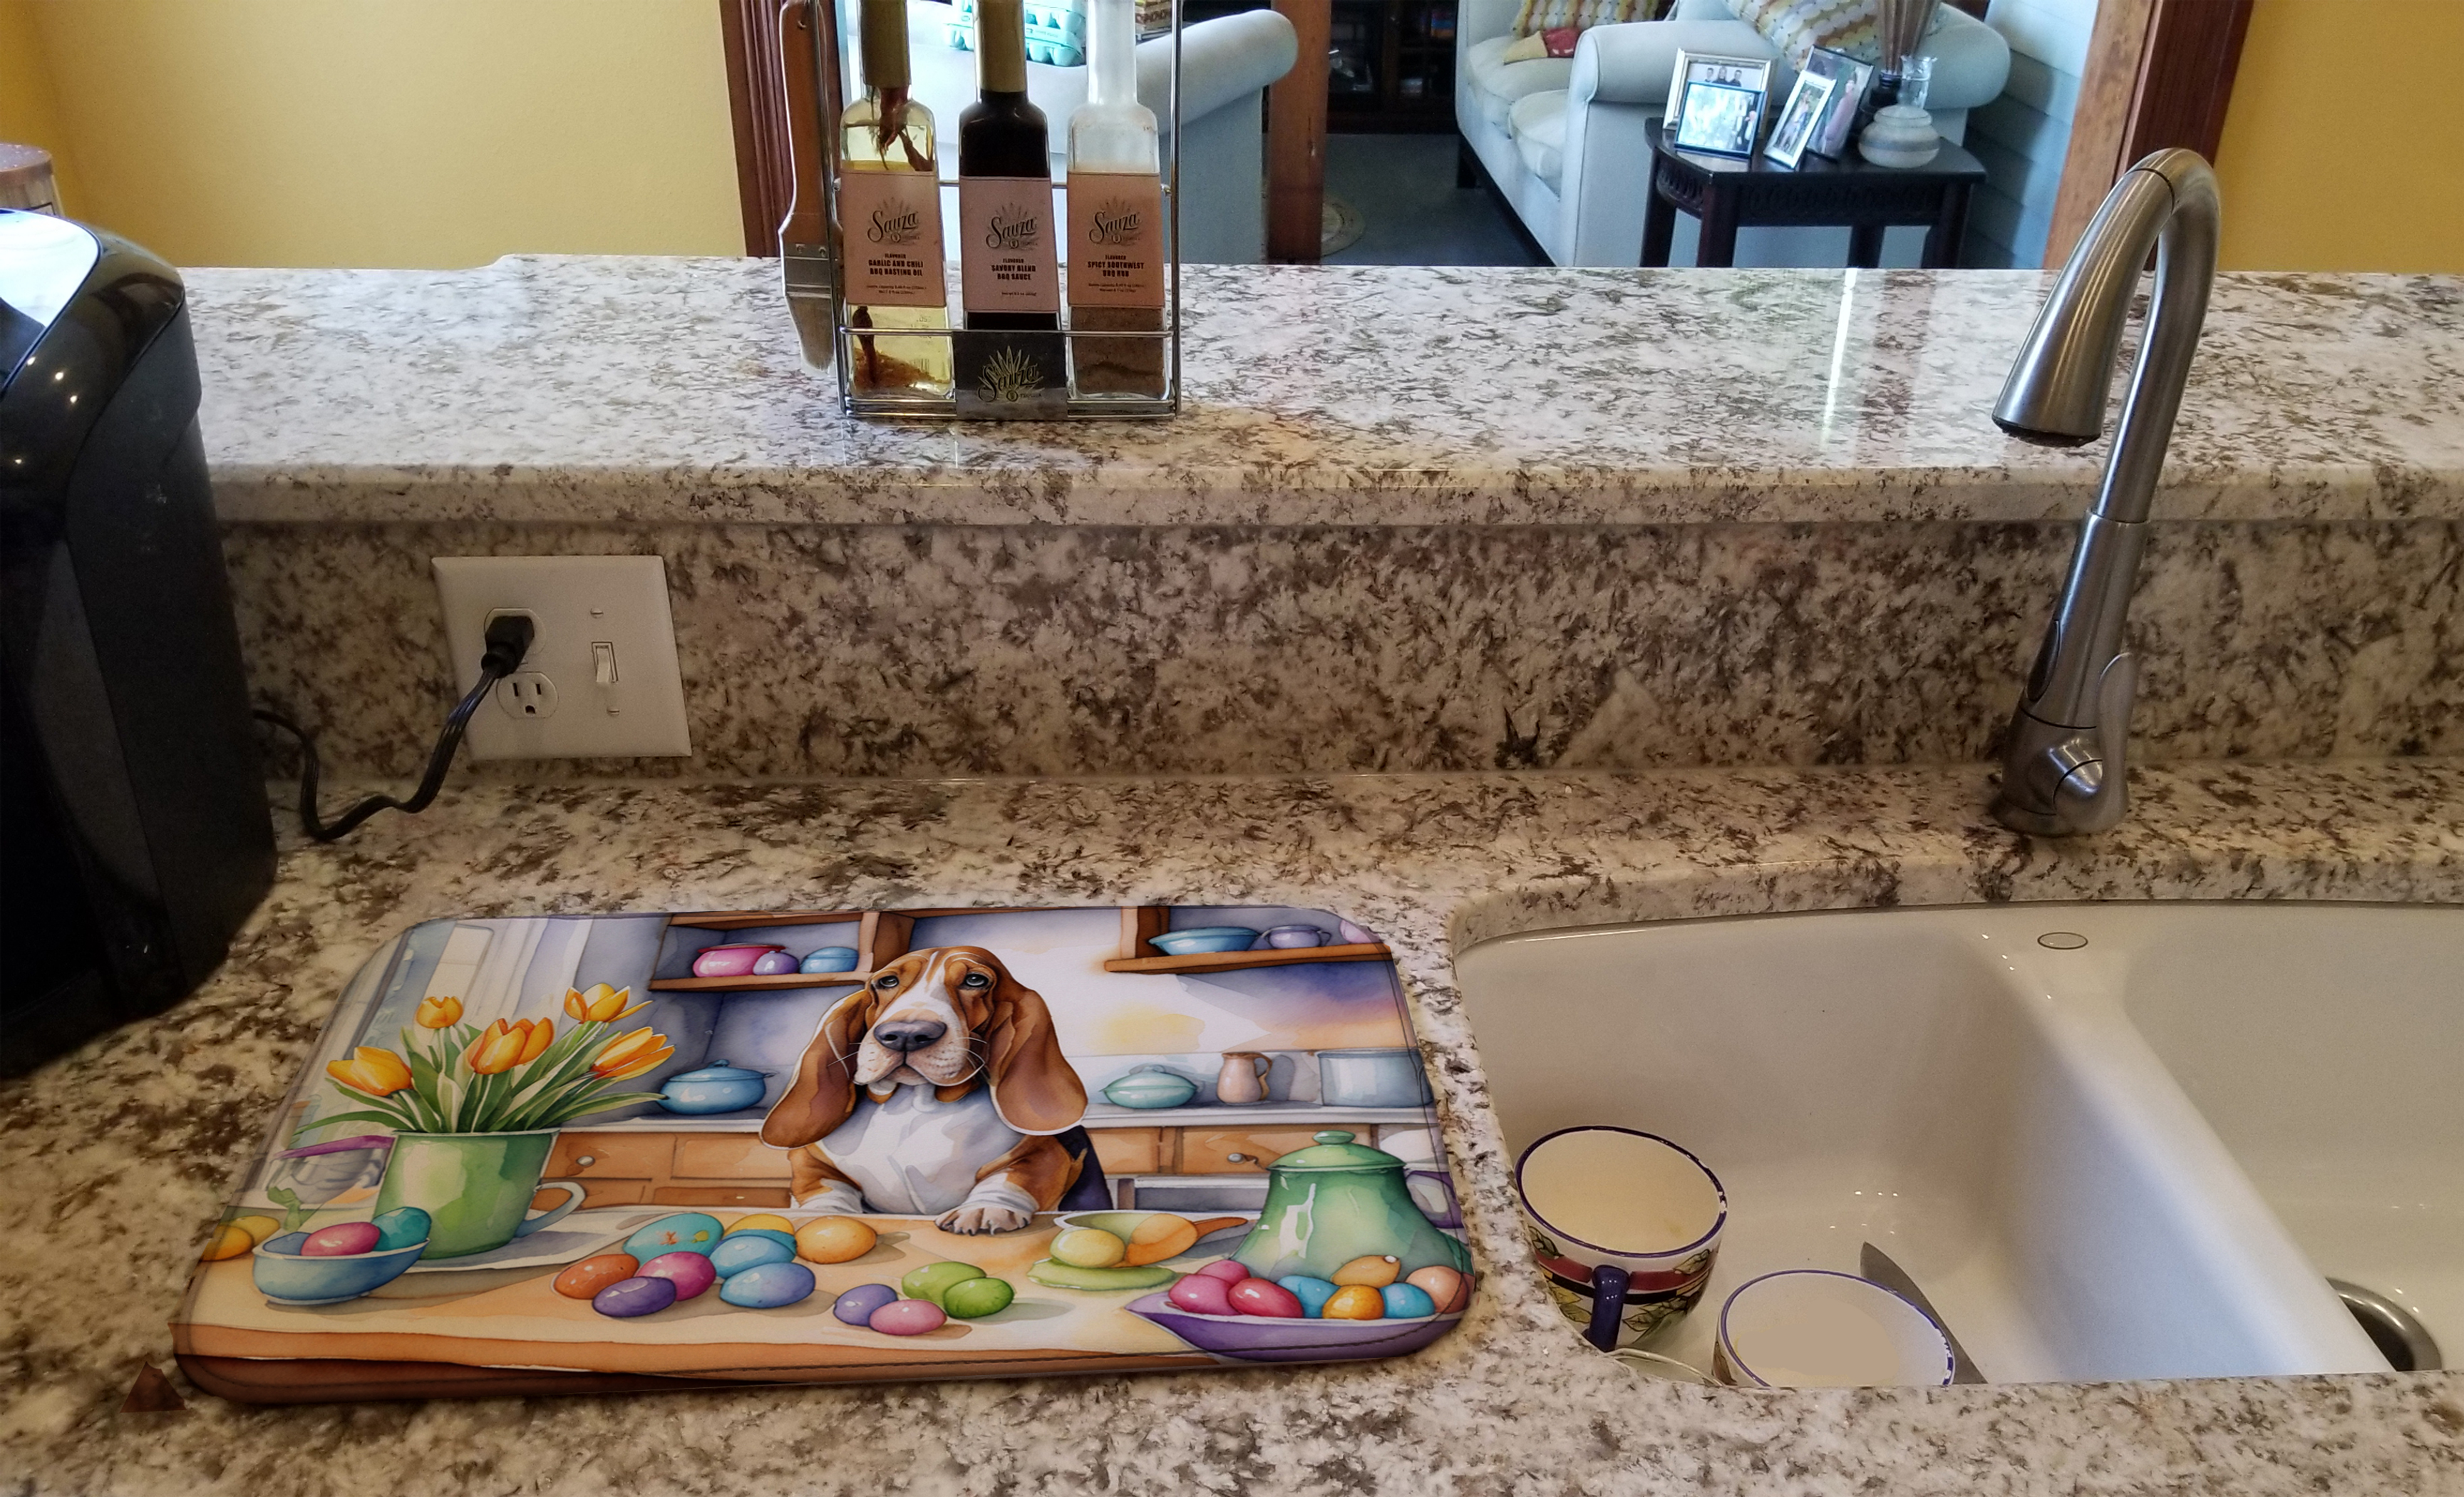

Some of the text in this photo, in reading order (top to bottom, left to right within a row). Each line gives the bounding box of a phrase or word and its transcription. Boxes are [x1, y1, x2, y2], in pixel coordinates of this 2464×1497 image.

[867, 210, 919, 243] Sauza
[986, 216, 1037, 249] Sauza
[1089, 211, 1140, 244] Sauza
[1108, 261, 1145, 269] SOUTHWEST
[978, 365, 1039, 403] Sauza
